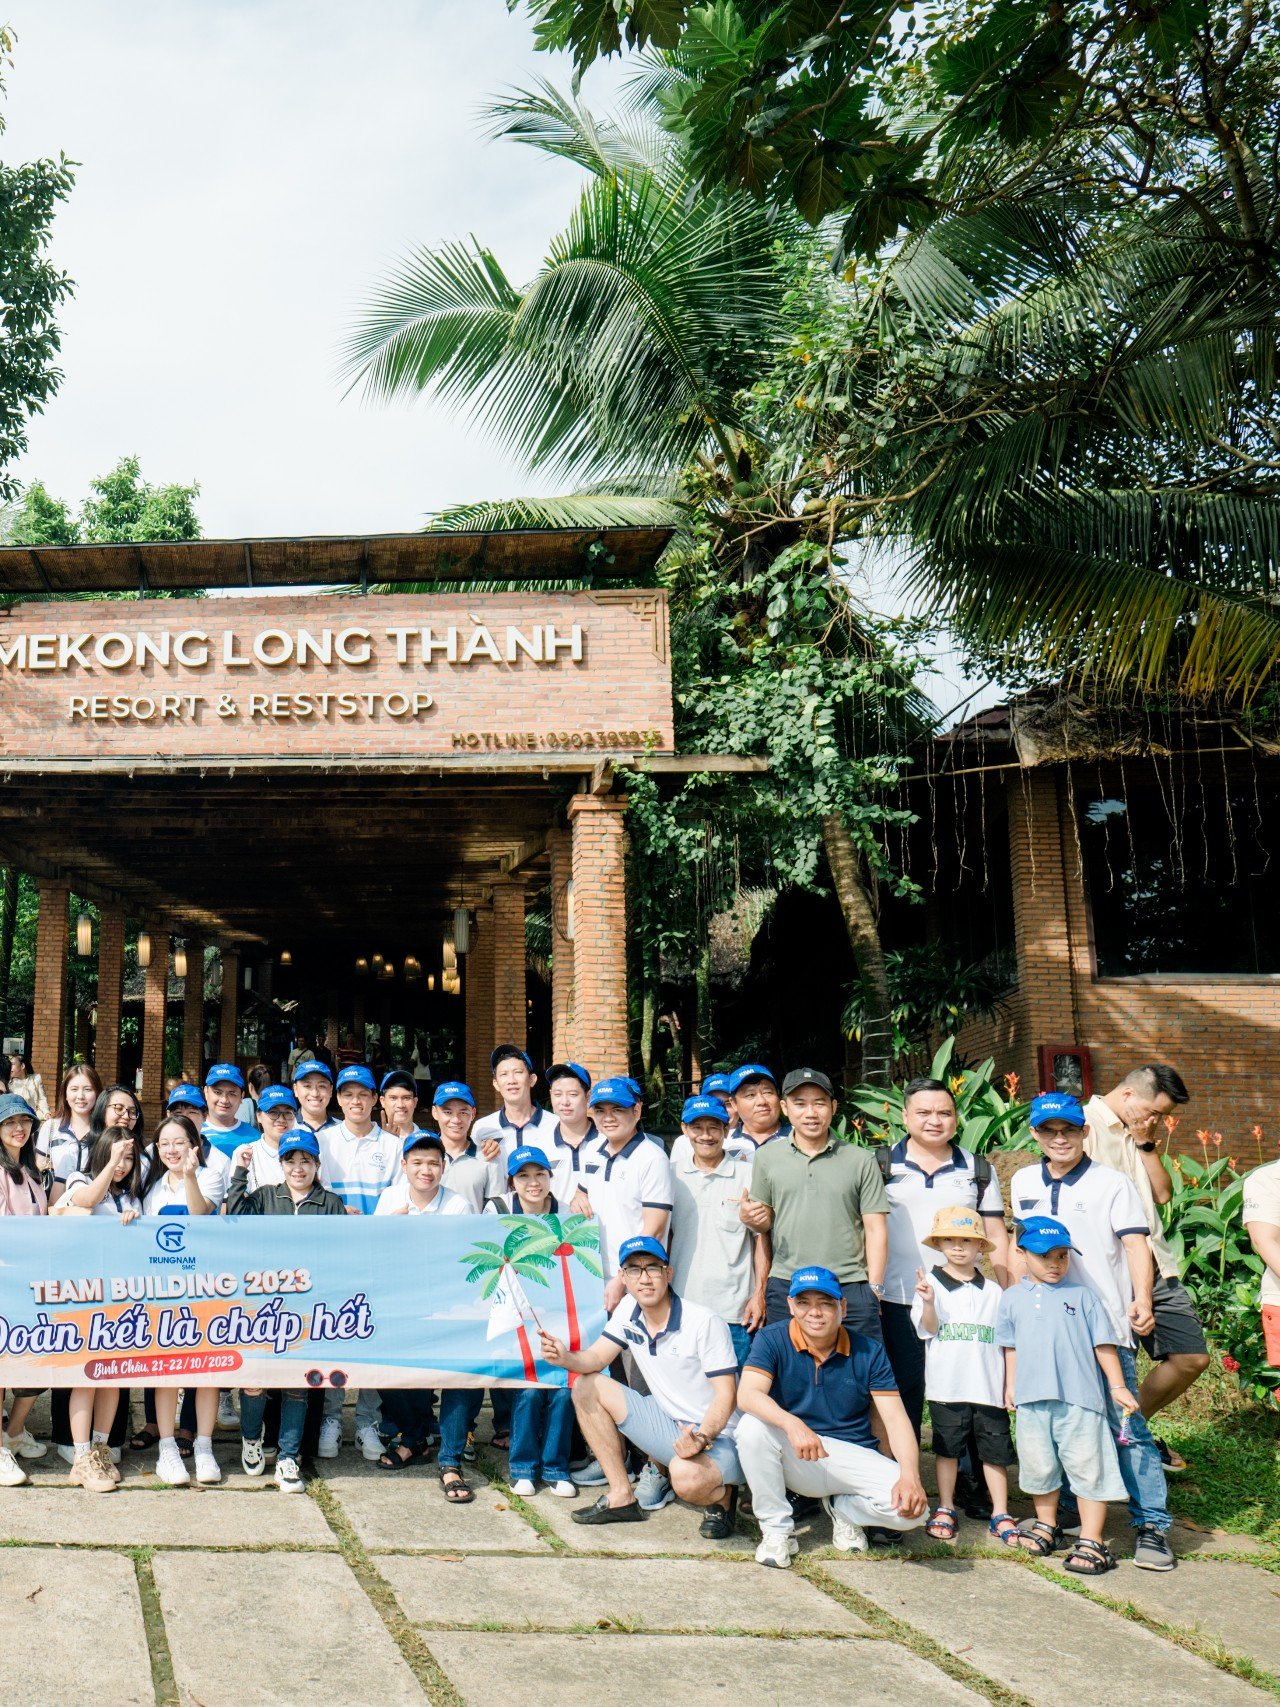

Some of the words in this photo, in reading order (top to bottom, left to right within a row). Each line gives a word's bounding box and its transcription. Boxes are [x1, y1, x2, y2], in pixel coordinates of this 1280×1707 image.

[223, 626, 373, 667] LONG
[385, 613, 584, 665] THÀNH
[69, 694, 203, 720] RESORT
[215, 693, 238, 717] &
[249, 691, 435, 717] RESTSTOP
[739, 1068, 754, 1077] KIWI
[516, 1152, 532, 1160] KIWI
[627, 1241, 644, 1249] KIWI
[149, 1256, 196, 1264] TRUNGNAM
[29, 1277, 104, 1305] TEAM
[110, 1272, 239, 1301] BUILDING
[243, 1267, 314, 1296] 2023
[87, 1302, 152, 1352] kết
[157, 1306, 203, 1348] là
[206, 1296, 303, 1355] chấp
[309, 1292, 375, 1342] hết
[937, 1322, 995, 1344] CAMPIN
[93, 1359, 118, 1377] Bình
[151, 1355, 235, 1372] 21-22/10/2023
